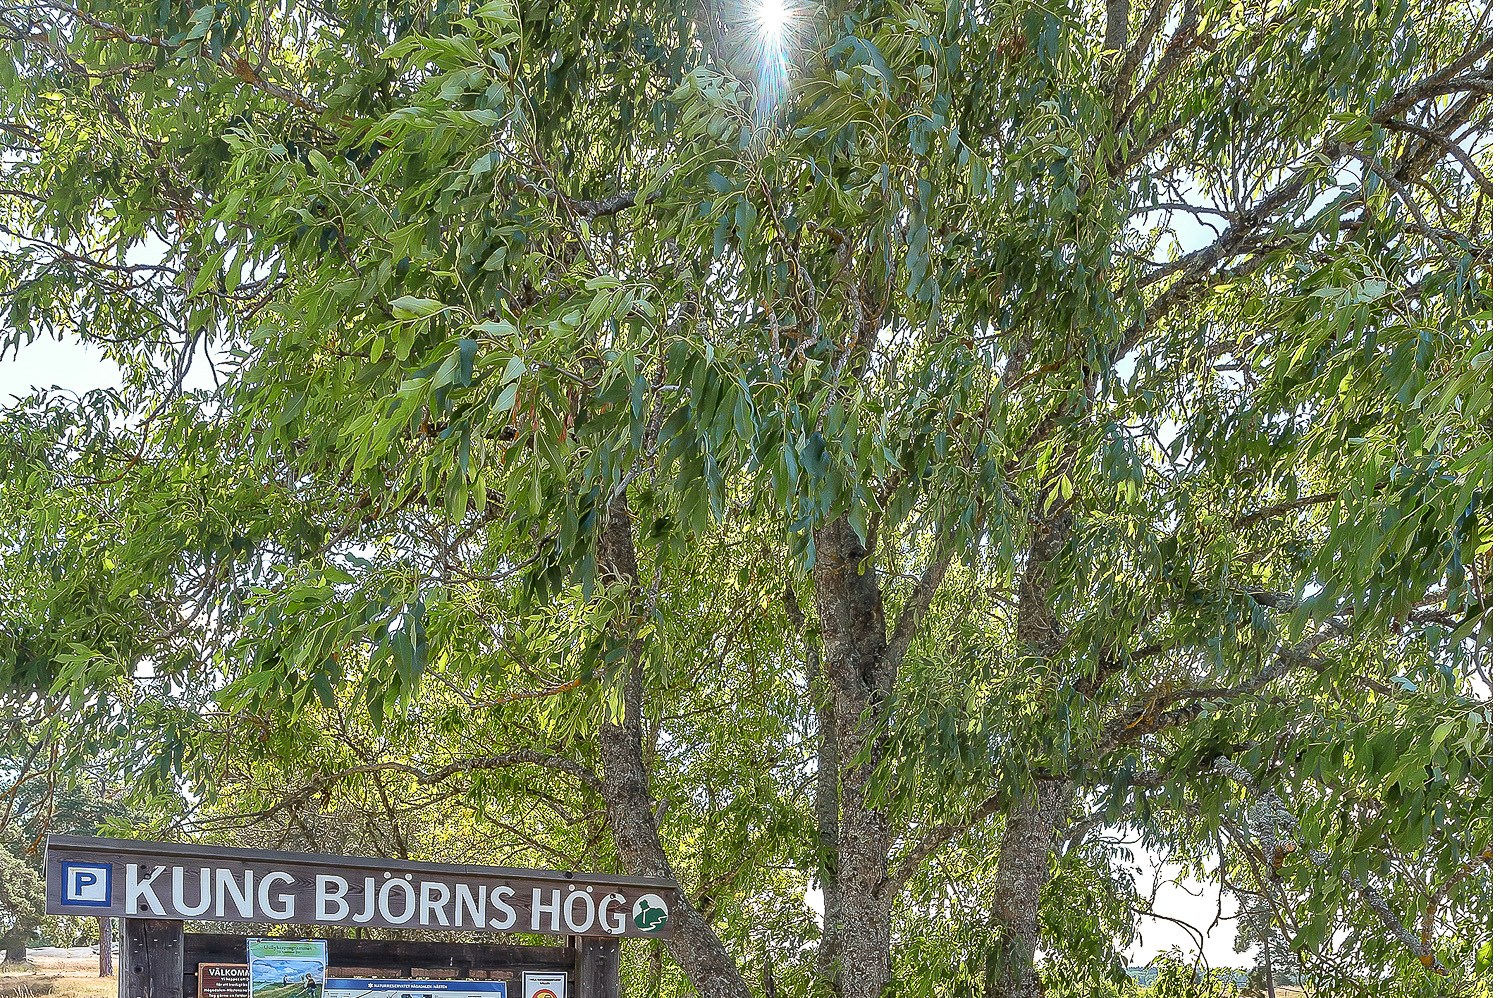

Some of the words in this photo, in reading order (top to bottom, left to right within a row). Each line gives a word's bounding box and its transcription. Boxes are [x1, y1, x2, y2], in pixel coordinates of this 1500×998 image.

[75, 871, 97, 896] P
[125, 863, 296, 920] KUNG
[315, 871, 517, 931] BJÖRNS
[531, 883, 627, 935] HÖG
